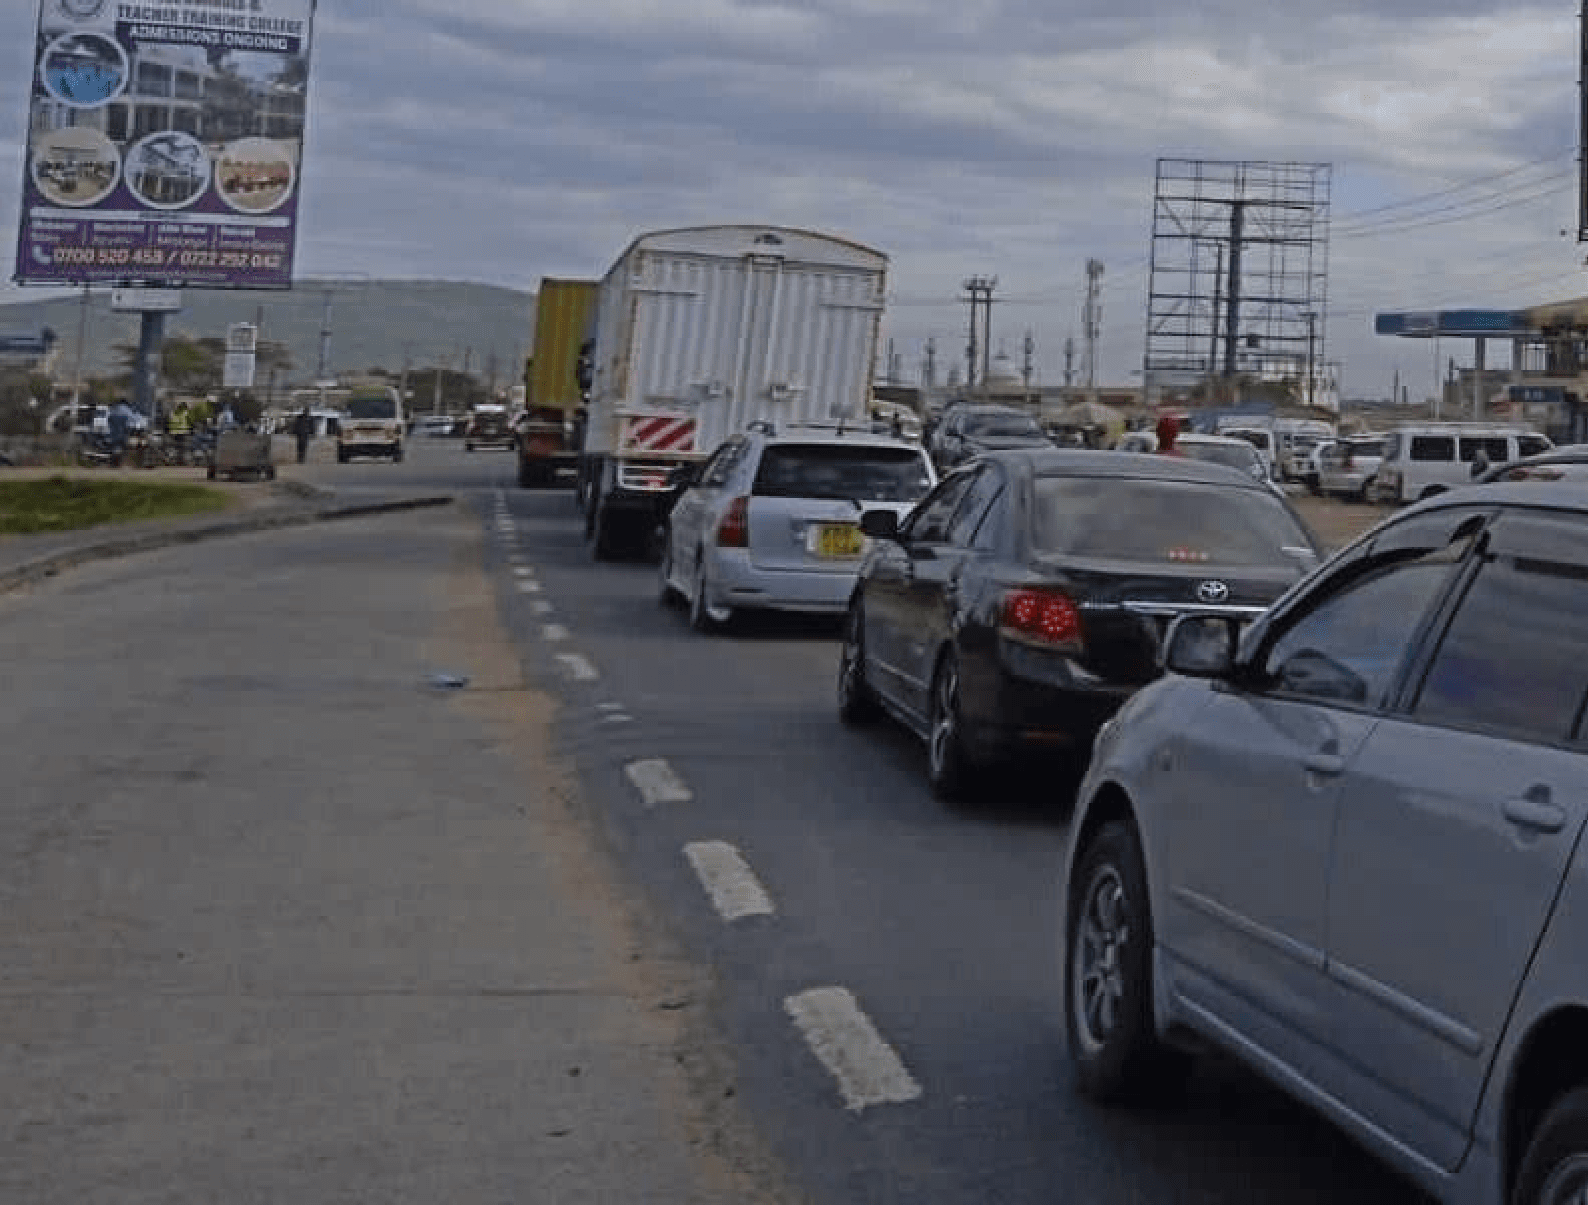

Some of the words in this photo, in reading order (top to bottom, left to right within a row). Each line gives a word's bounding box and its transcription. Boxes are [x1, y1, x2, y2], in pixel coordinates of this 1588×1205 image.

[118, 4, 178, 23] TEACHER
[182, 9, 247, 29] TRAINING
[250, 16, 305, 35] COLLEGE
[130, 24, 220, 46] ADMISSIONS
[224, 31, 288, 50] ONGOING
